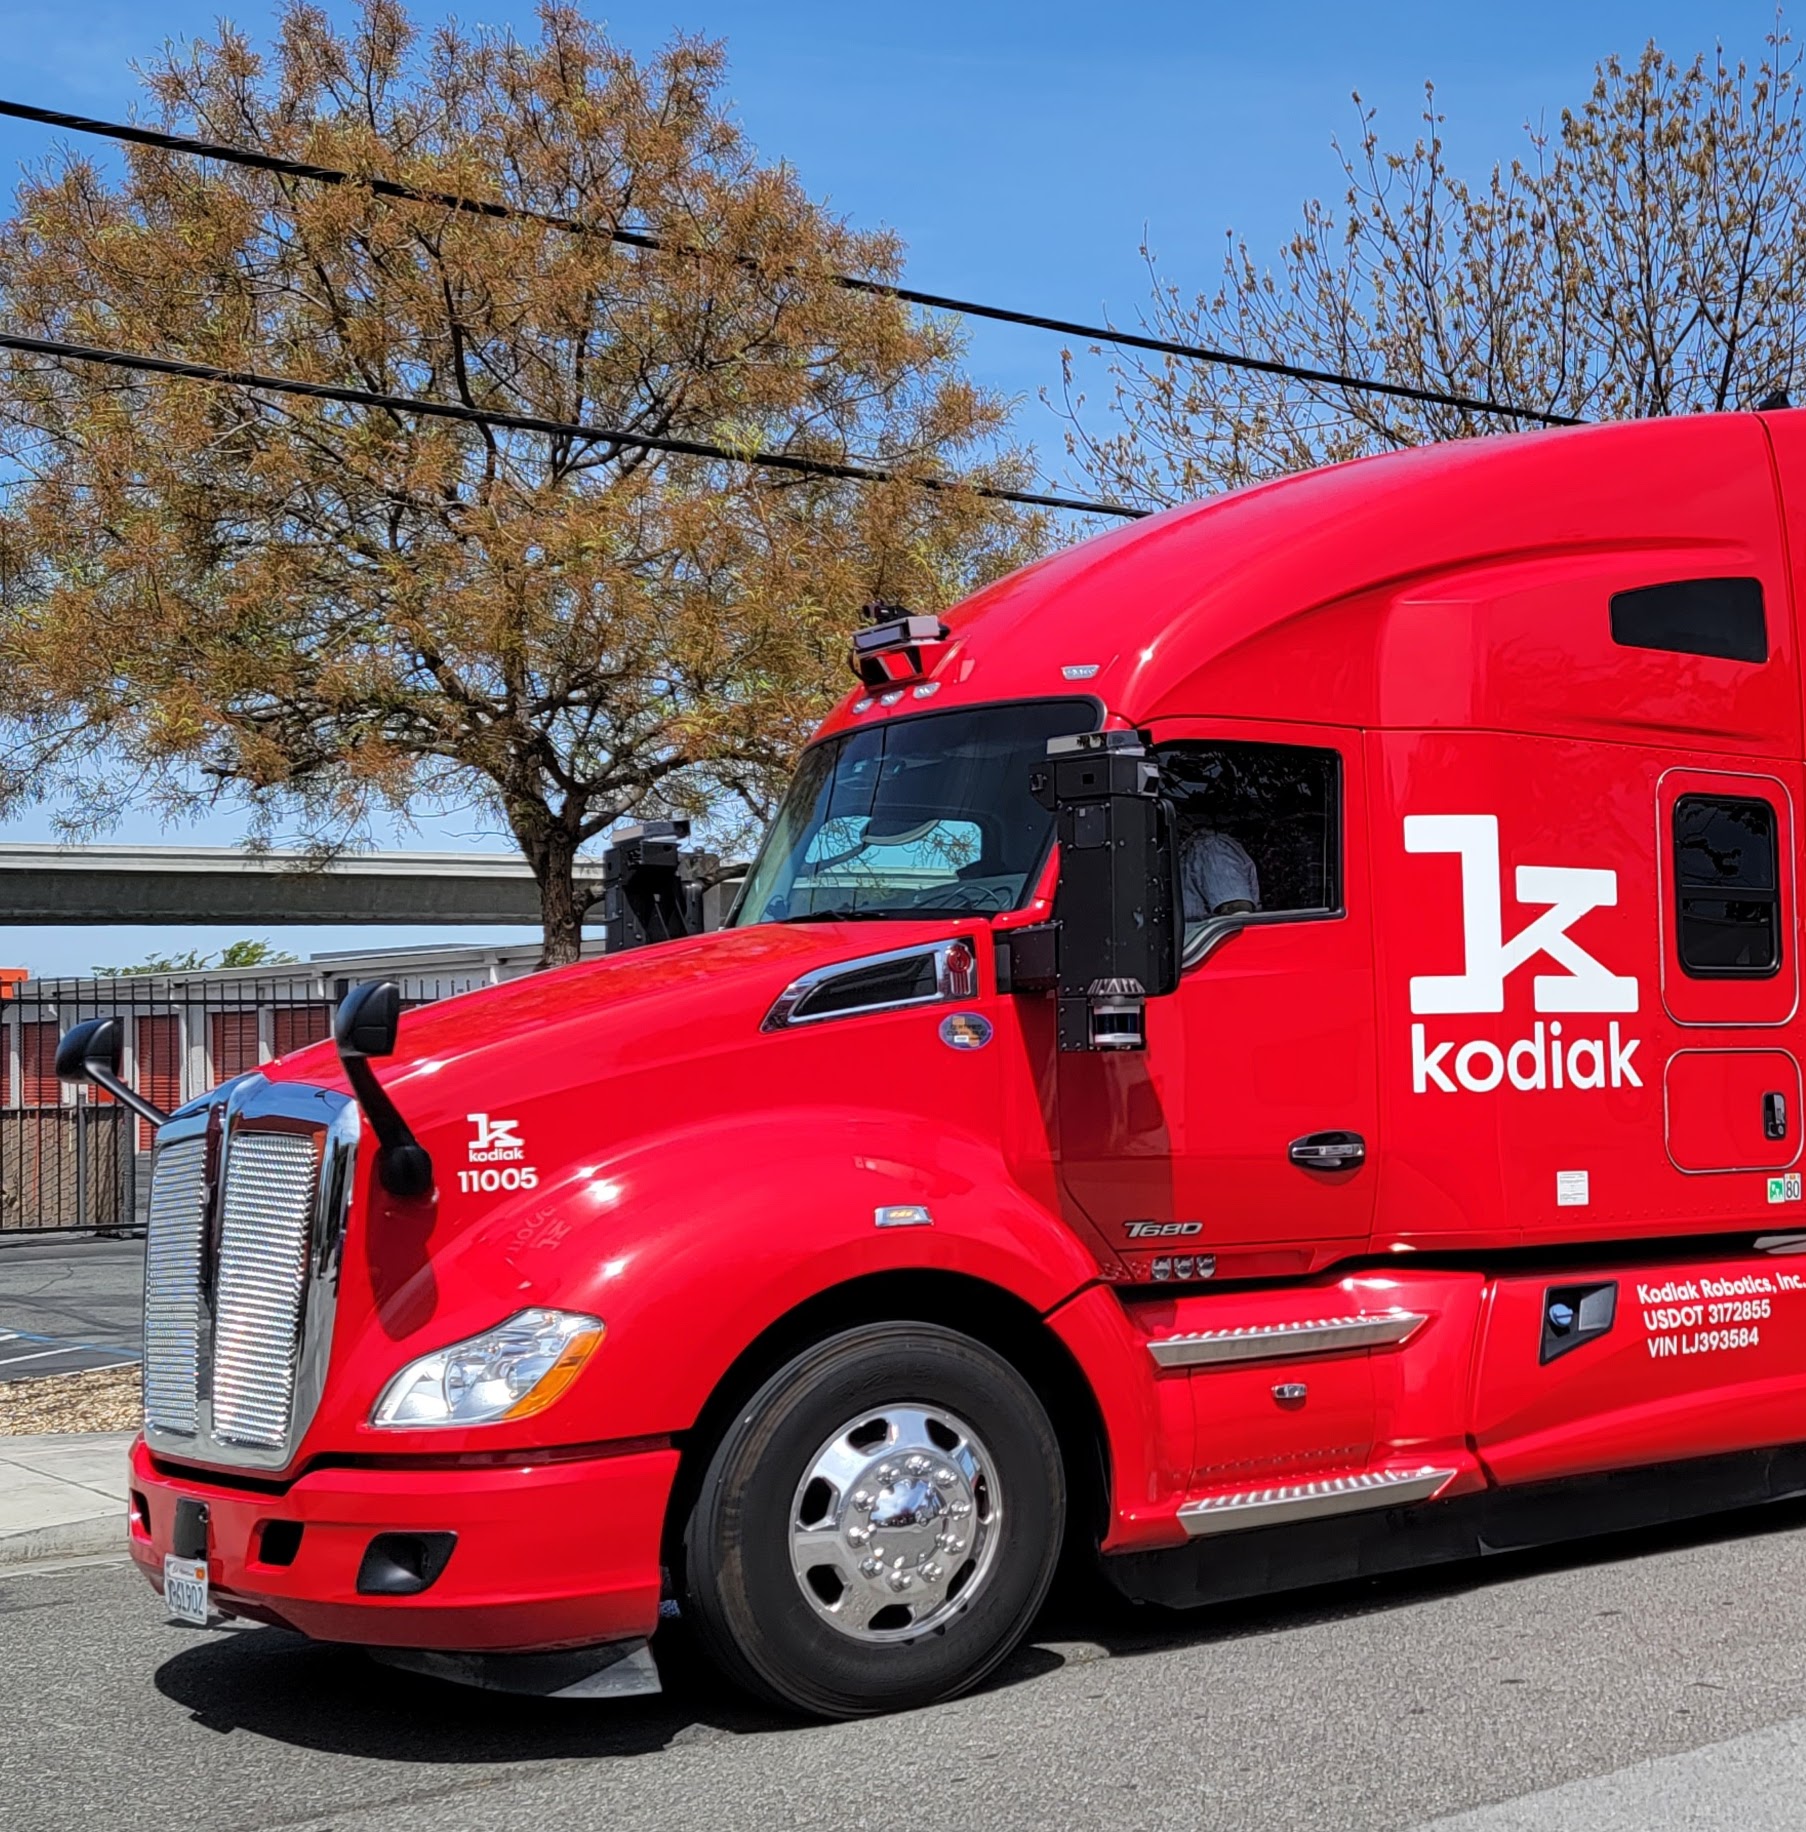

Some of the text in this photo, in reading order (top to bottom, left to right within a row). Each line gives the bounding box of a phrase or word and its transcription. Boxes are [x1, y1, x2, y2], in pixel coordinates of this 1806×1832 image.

[1410, 1020, 1645, 1094] kodiak
[468, 1147, 526, 1163] kodiak
[457, 1166, 539, 1193] 11005
[1786, 1180, 1800, 1198] 80
[1123, 1220, 1204, 1239] T680
[1636, 1280, 1700, 1305] Kodiak
[1700, 1275, 1777, 1298] Robotics,
[1643, 1298, 1772, 1331] USDOT 3172855
[1647, 1326, 1760, 1359] VIN LJ393584
